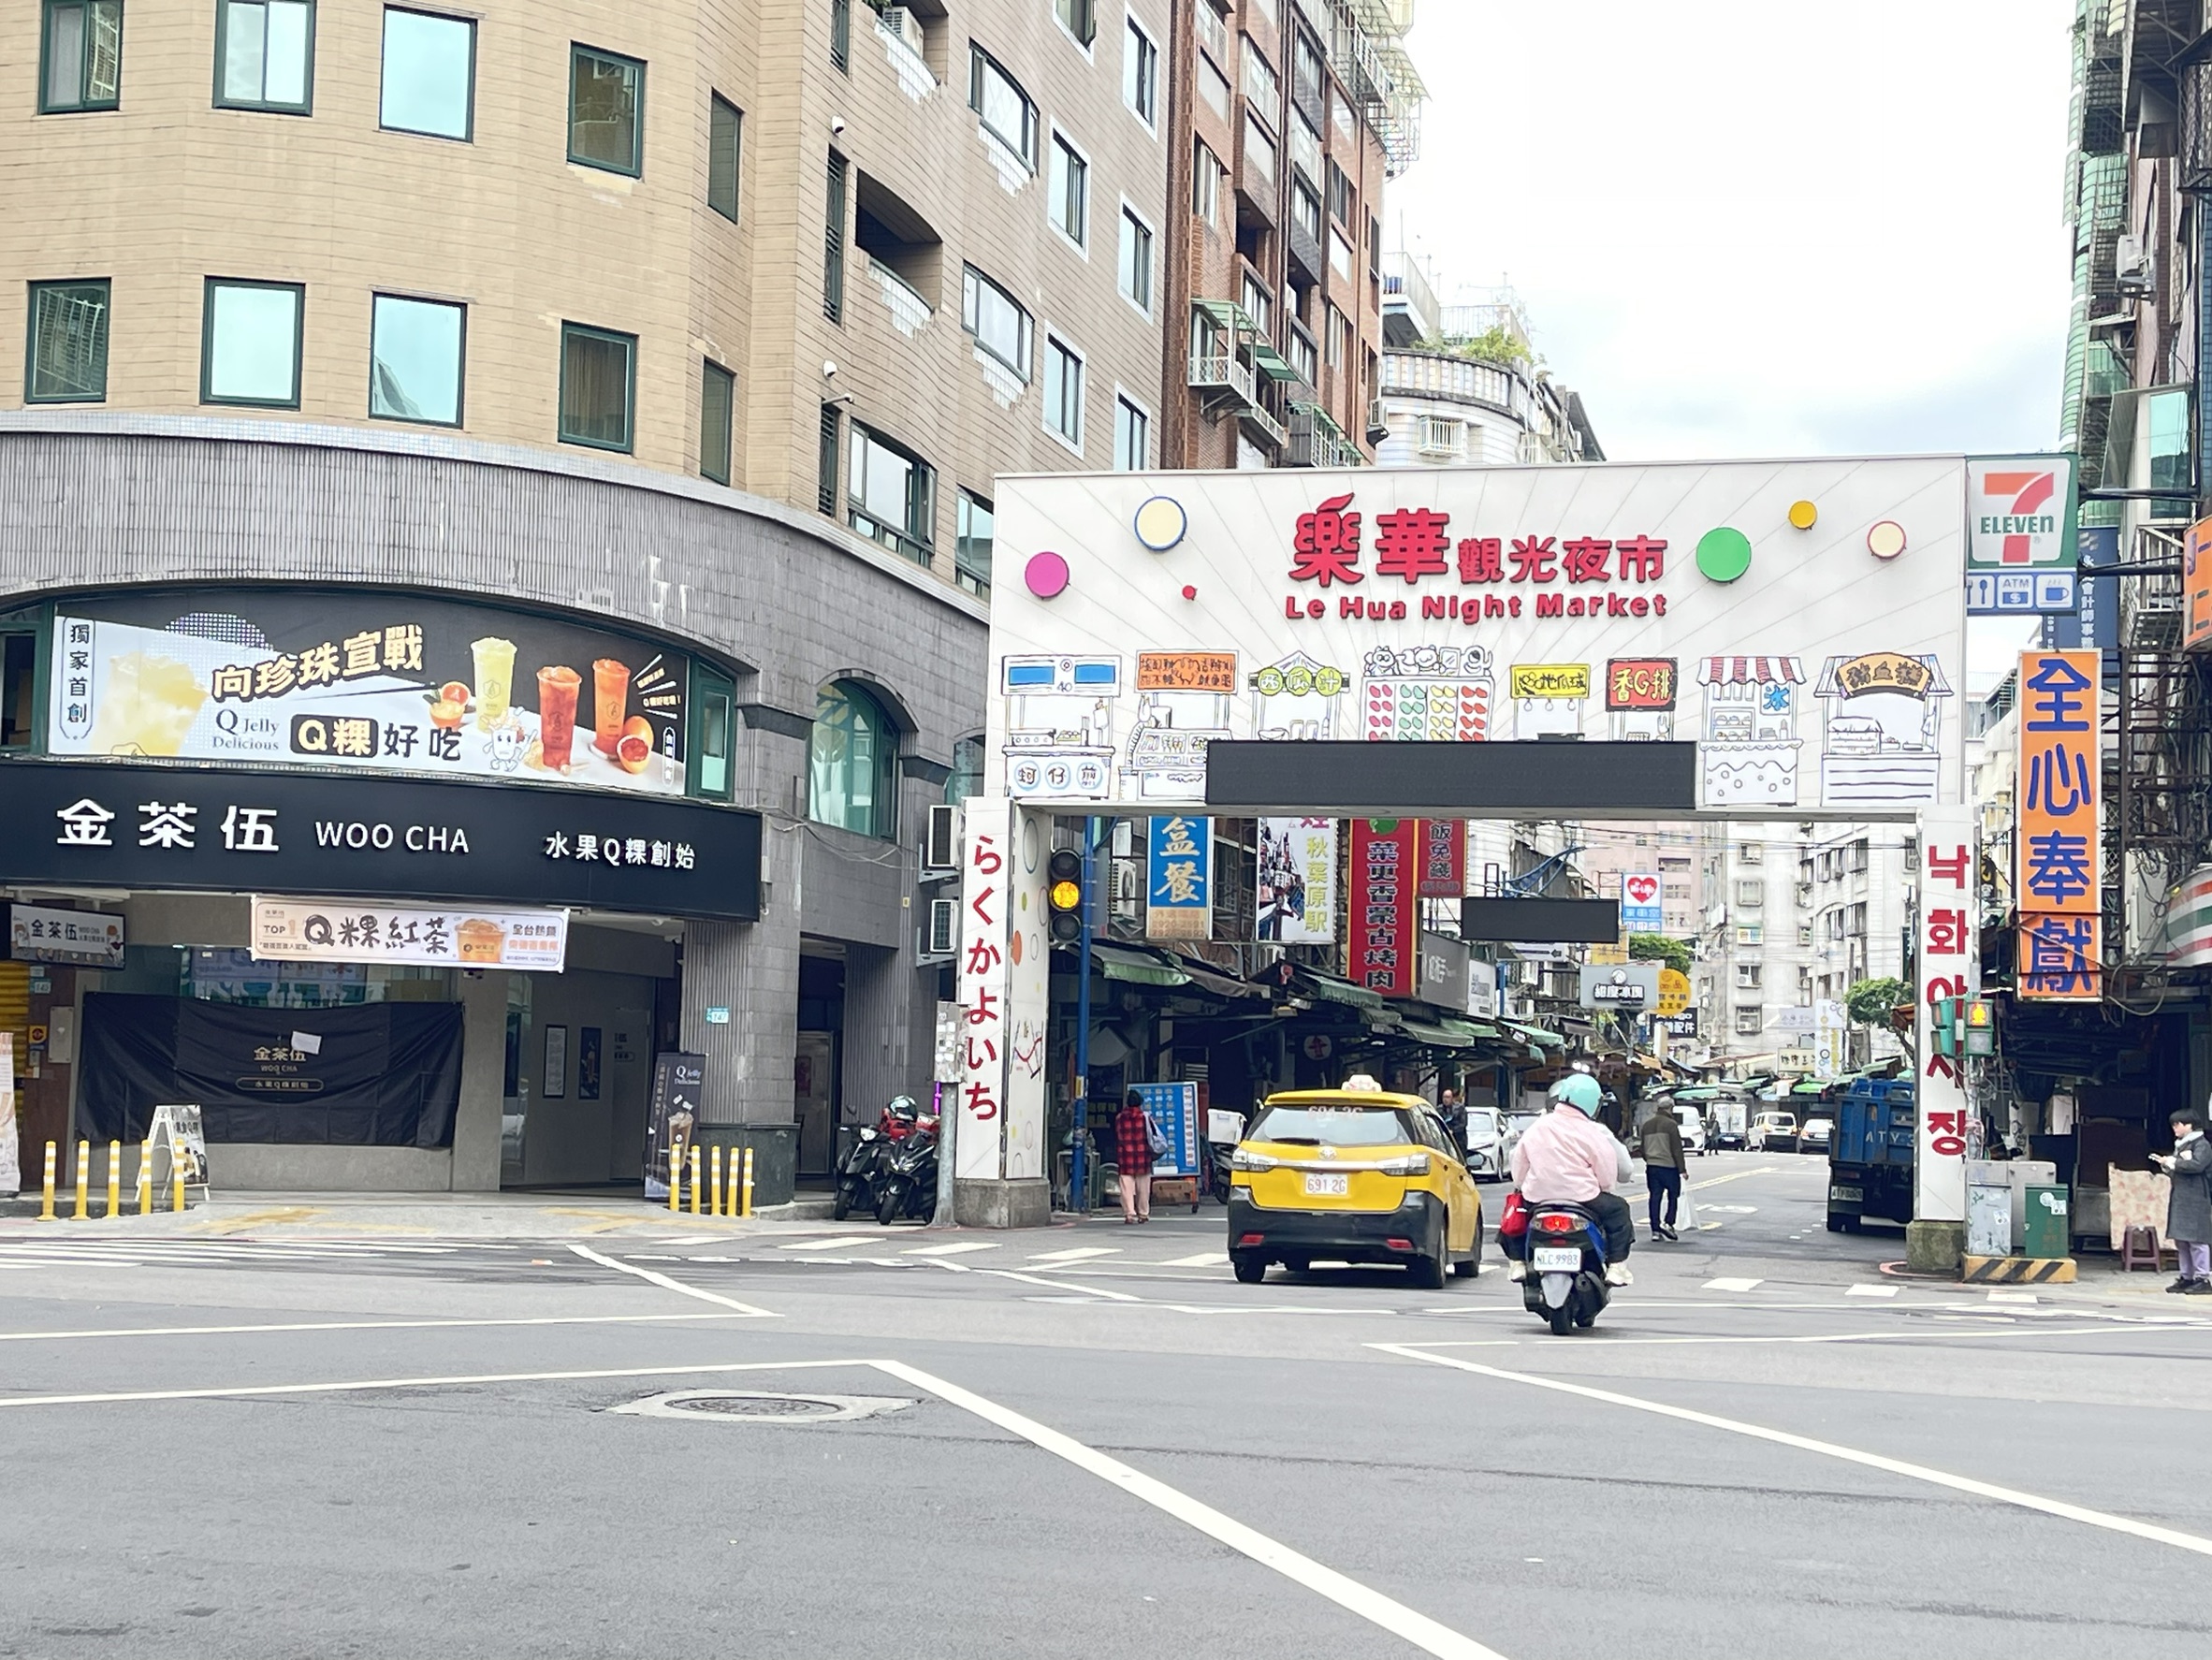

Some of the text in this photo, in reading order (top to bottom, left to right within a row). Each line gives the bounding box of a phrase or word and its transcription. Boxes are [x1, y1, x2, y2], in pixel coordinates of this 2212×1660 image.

[1288, 492, 1668, 588] 樂華觀光夜市
[2002, 578, 2030, 589] ATM
[1286, 592, 1667, 625] Le Hua Night Market
[67, 624, 90, 723] 獨家首創
[212, 624, 424, 701] 向珍珠宣戰
[1259, 670, 1340, 692] 西瓜汁
[1612, 667, 1672, 703] 香G排
[1763, 684, 1790, 711] 冰
[215, 709, 280, 736] Q Jelly
[298, 718, 463, 762] Q粿好吃
[212, 735, 279, 750] Delicious
[56, 798, 279, 852] 金茶伍
[315, 822, 470, 853] WOO CHA
[2026, 659, 2092, 994] 全心奉獻
[546, 831, 695, 869] 水果Q粿創始
[1154, 817, 1204, 903] 盒餐
[1428, 818, 1452, 879] 飯免錢
[1304, 837, 1330, 934] 秋葉原駅
[31, 919, 78, 940] 金茶伍
[264, 925, 286, 934] TOP
[304, 914, 450, 955] Q粿紅茶
[966, 836, 1002, 1121] らくかよいち
[254, 1047, 306, 1061] 金茶伍
